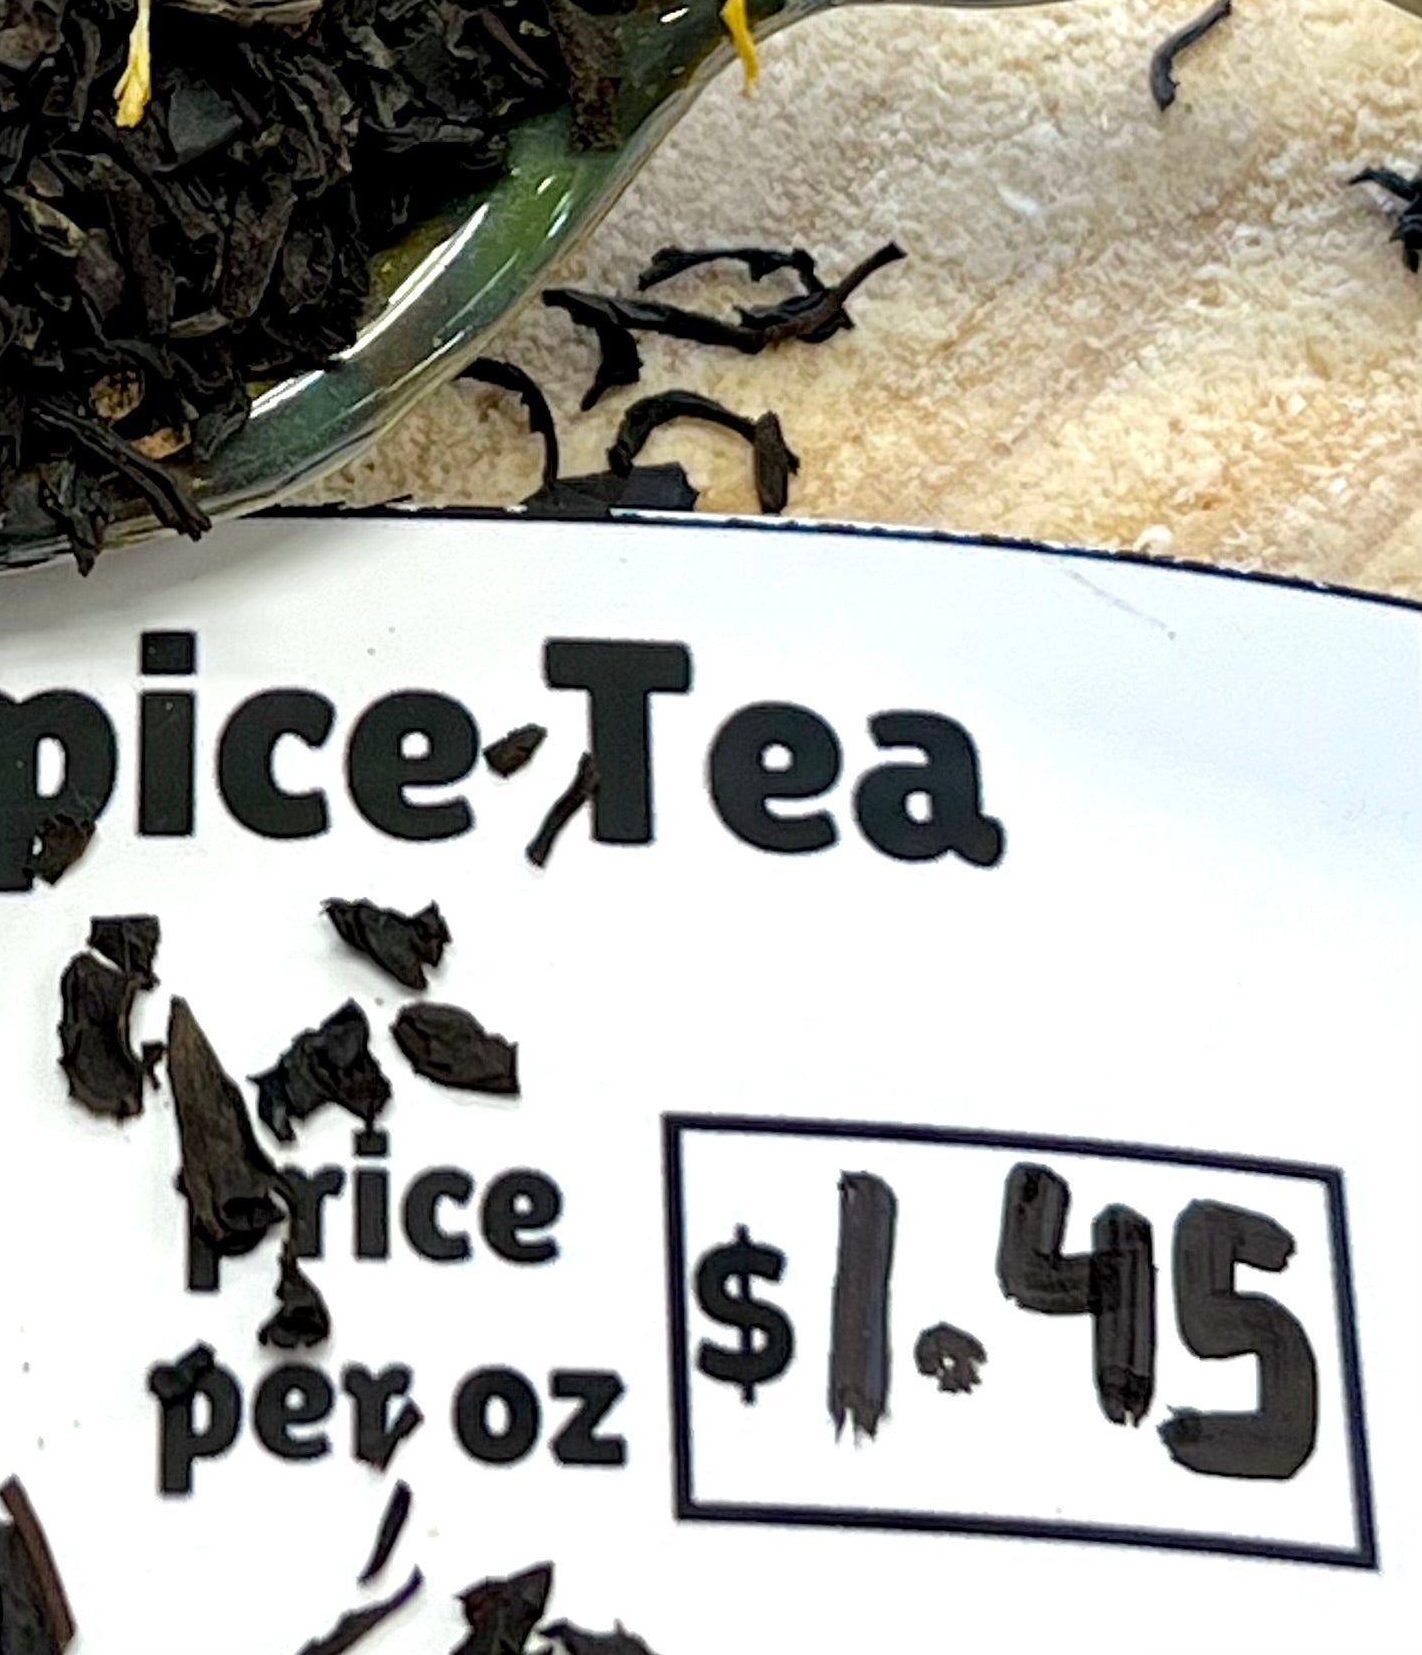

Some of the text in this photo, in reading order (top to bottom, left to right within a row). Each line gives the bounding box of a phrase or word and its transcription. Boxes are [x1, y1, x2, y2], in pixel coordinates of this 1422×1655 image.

[542, 636, 1007, 869] Tea
[146, 1353, 628, 1500] per oz
